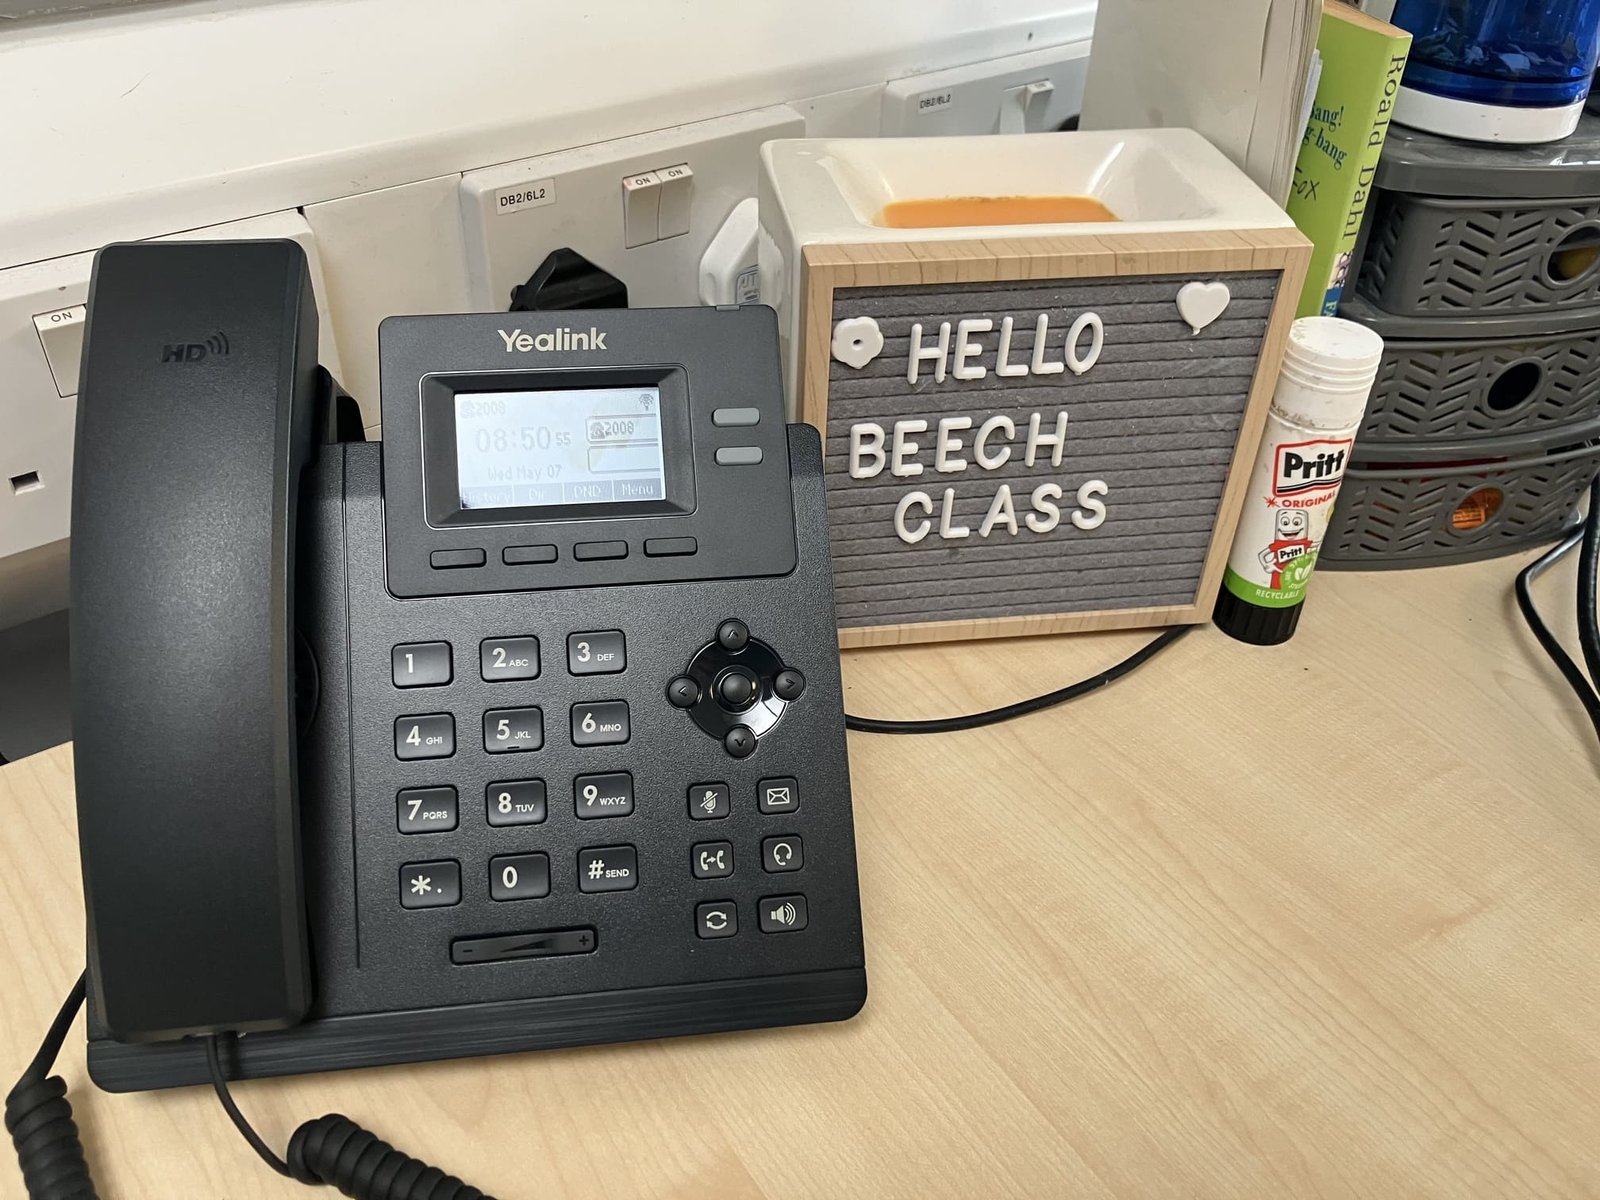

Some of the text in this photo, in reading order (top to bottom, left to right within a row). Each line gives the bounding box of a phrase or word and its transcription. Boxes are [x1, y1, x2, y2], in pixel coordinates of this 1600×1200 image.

[1343, 52, 1408, 241] Roald Dahl
[635, 177, 652, 187] ON
[667, 168, 684, 178] ON
[500, 188, 546, 207] DB2/6L2
[51, 311, 73, 323] ON
[498, 327, 607, 353] Yealink
[907, 312, 1104, 385] HELLO
[161, 344, 206, 363] HD
[475, 426, 571, 453] 08:50 55
[850, 411, 1068, 478] BEECH
[517, 465, 541, 480] May
[547, 464, 563, 479] 07
[1283, 450, 1345, 479] Pritt
[622, 482, 654, 497] Menu
[894, 480, 1108, 544] CLASS
[1279, 547, 1303, 560] Pritt
[492, 648, 529, 668] 2 ABC
[577, 642, 615, 662] 3 DEF
[405, 653, 415, 674] 1
[496, 720, 531, 740] 5 JKL
[582, 712, 622, 733] 6 MNO
[406, 726, 443, 746] 4 GHI
[498, 793, 534, 813] 8 TUV
[583, 785, 626, 806] 9 WXYZ
[407, 800, 448, 821] 7 PQRS
[502, 867, 518, 888] 0
